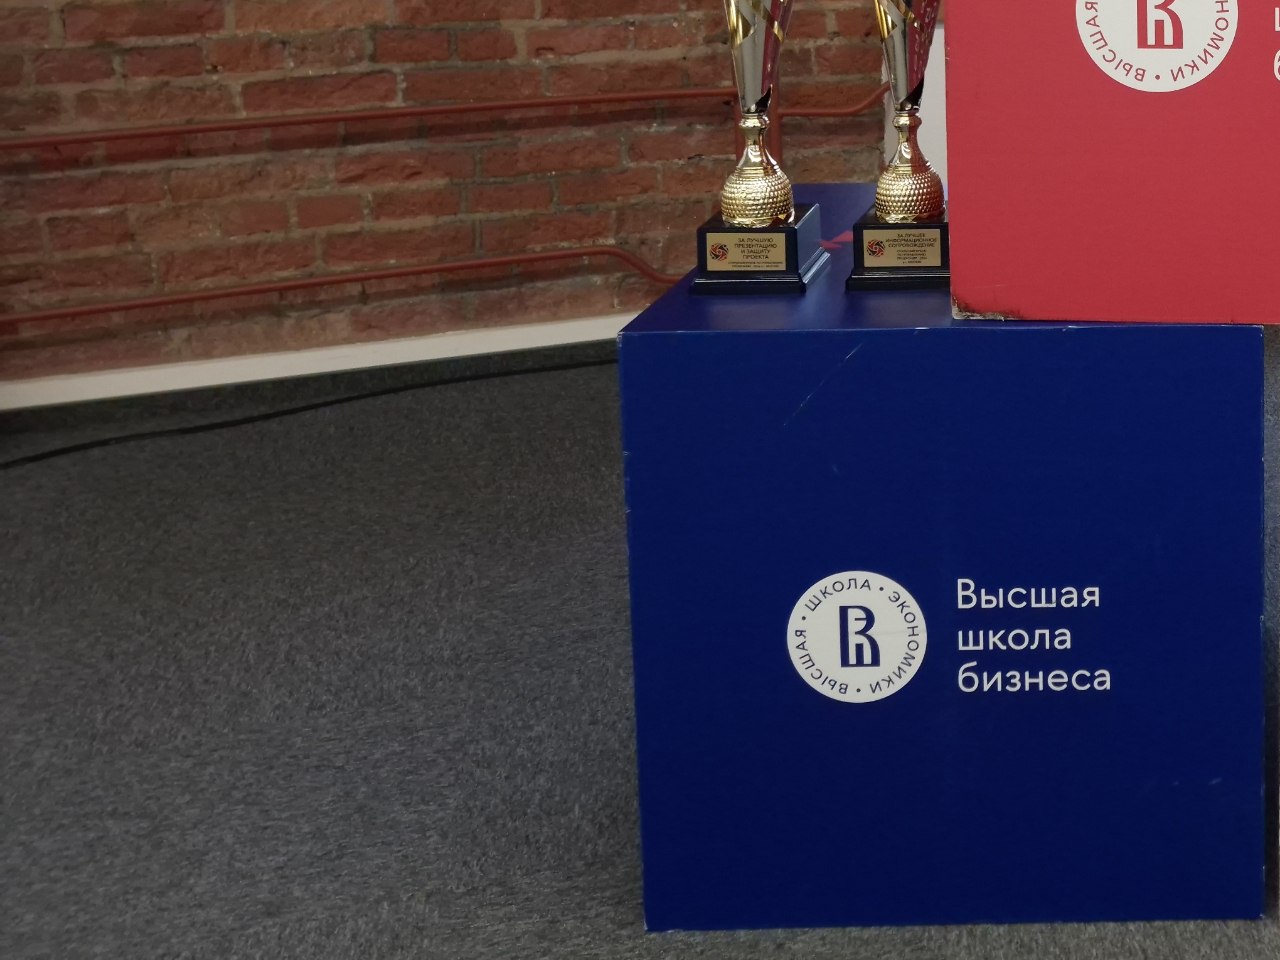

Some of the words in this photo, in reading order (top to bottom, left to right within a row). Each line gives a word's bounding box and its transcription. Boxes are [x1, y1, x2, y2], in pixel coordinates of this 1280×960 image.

[1084, 0, 1147, 83] ВЫСШАЯ
[805, 577, 872, 613] ШКОЛА
[956, 578, 1101, 609] Высшая
[870, 591, 920, 694] ЭКОНОМИКИ
[957, 628, 1072, 652] школа
[794, 628, 849, 695] ВЫСШАЯ
[957, 661, 1112, 693] бизнеса
